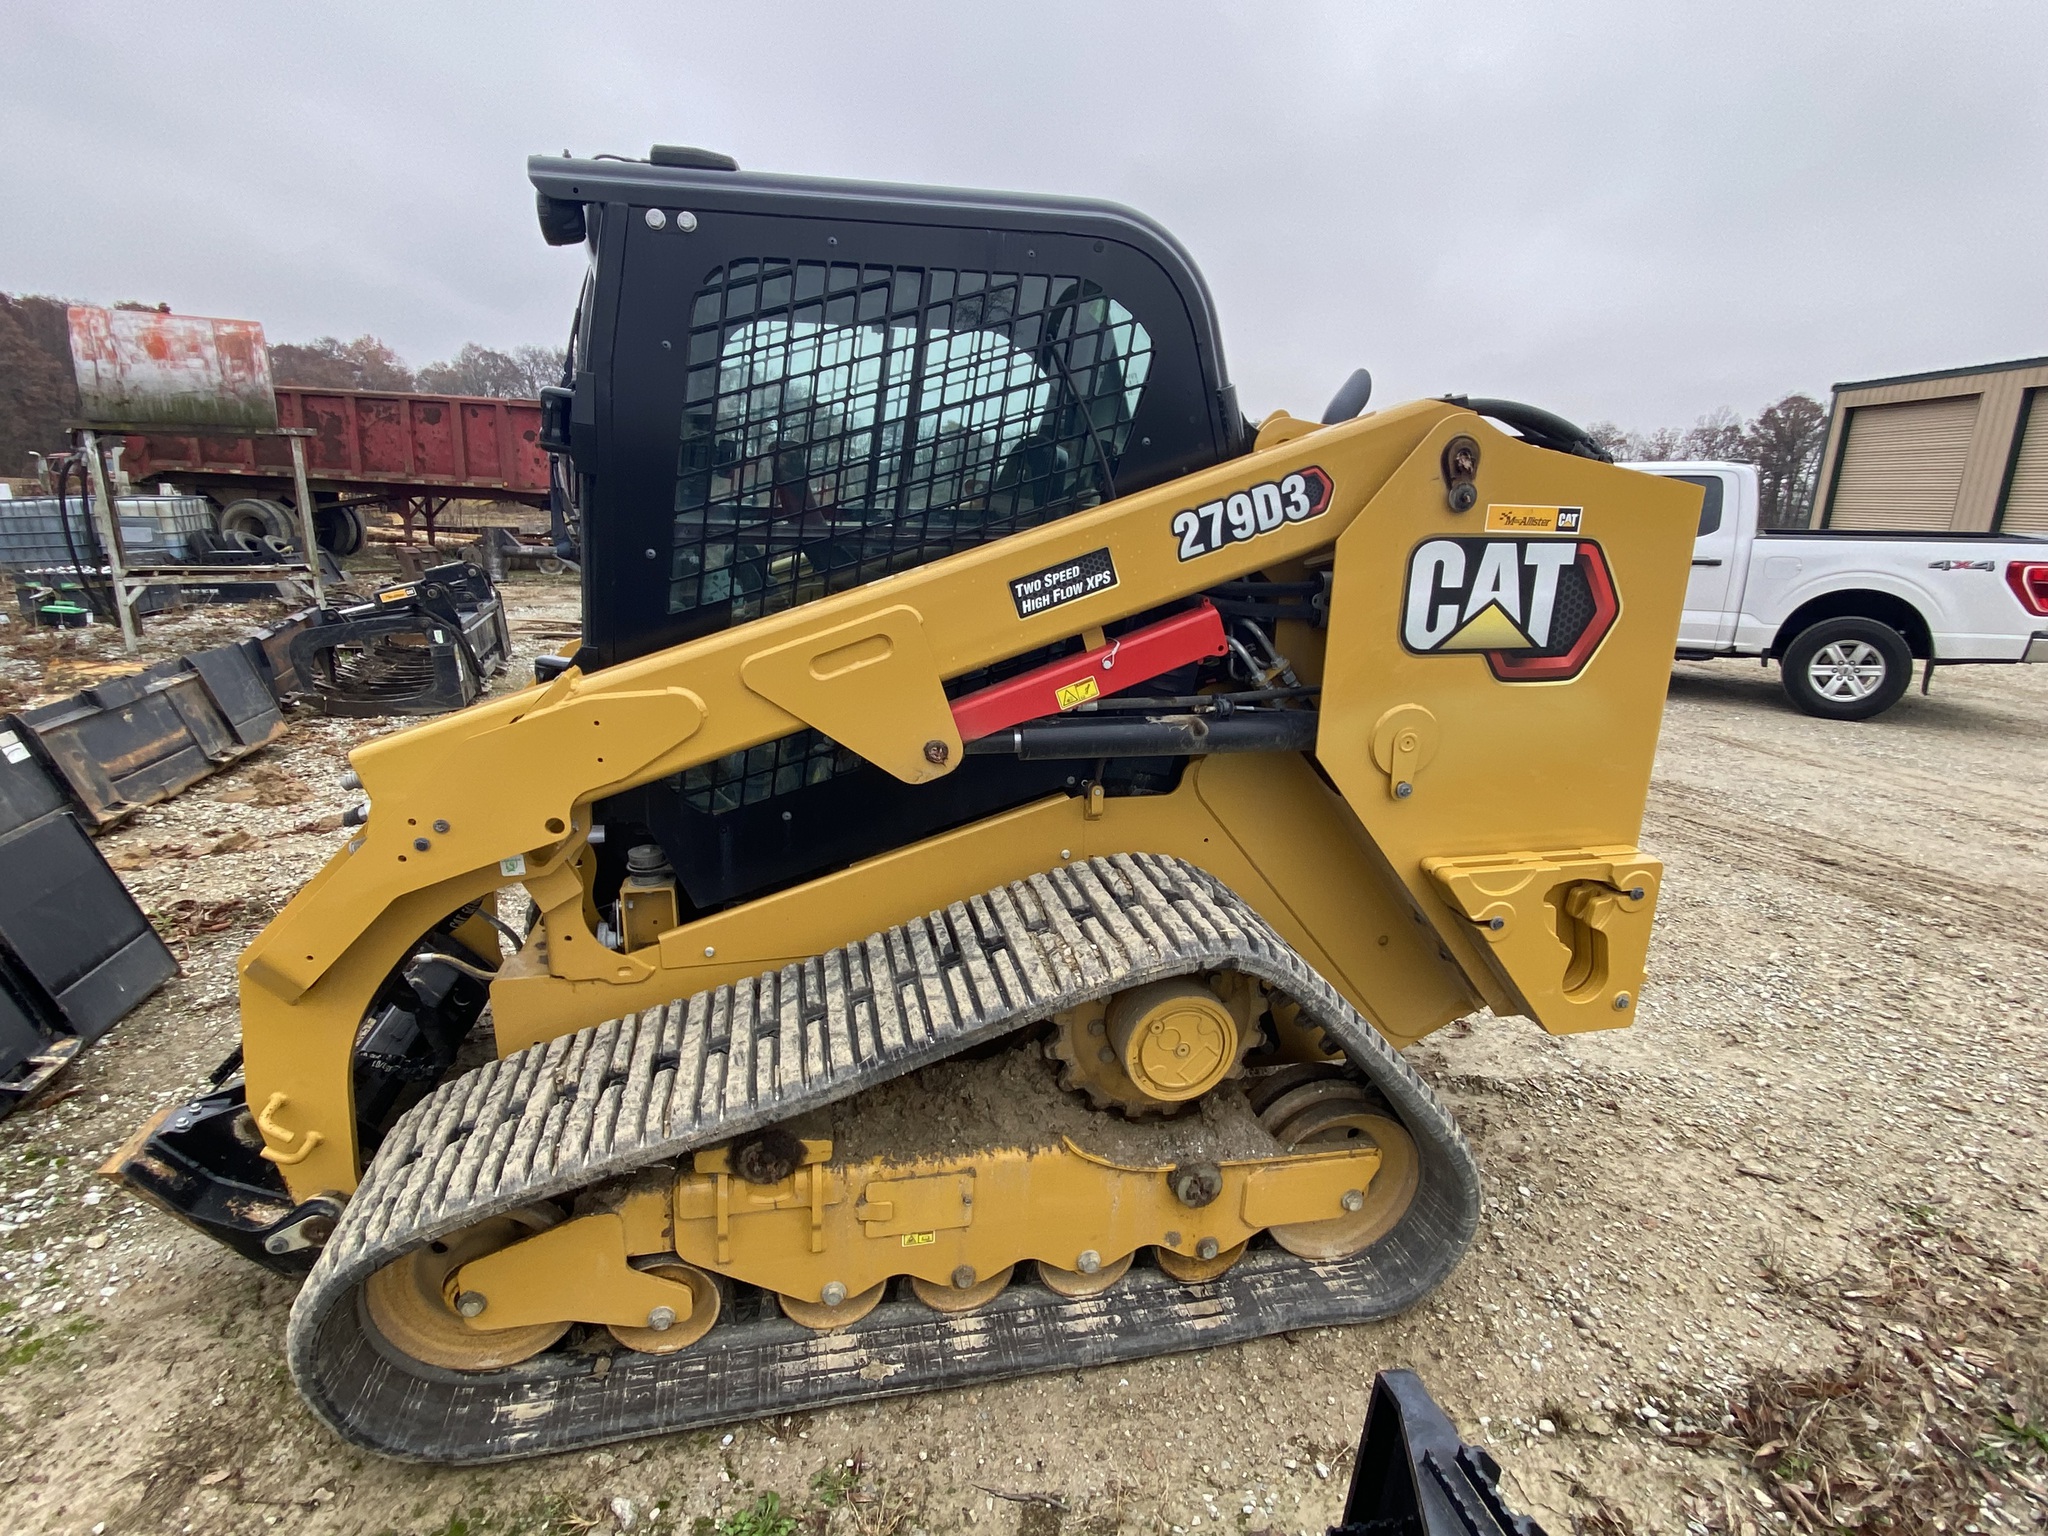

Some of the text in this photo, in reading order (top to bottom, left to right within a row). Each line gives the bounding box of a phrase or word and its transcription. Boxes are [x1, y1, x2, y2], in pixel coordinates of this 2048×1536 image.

[1173, 474, 1311, 560] 279D3
[1557, 512, 1579, 527] CAT
[1015, 565, 1080, 598] TWO SPEED
[1021, 570, 1111, 614] HIGH FLOW XPS
[1404, 540, 1577, 651] CAT
